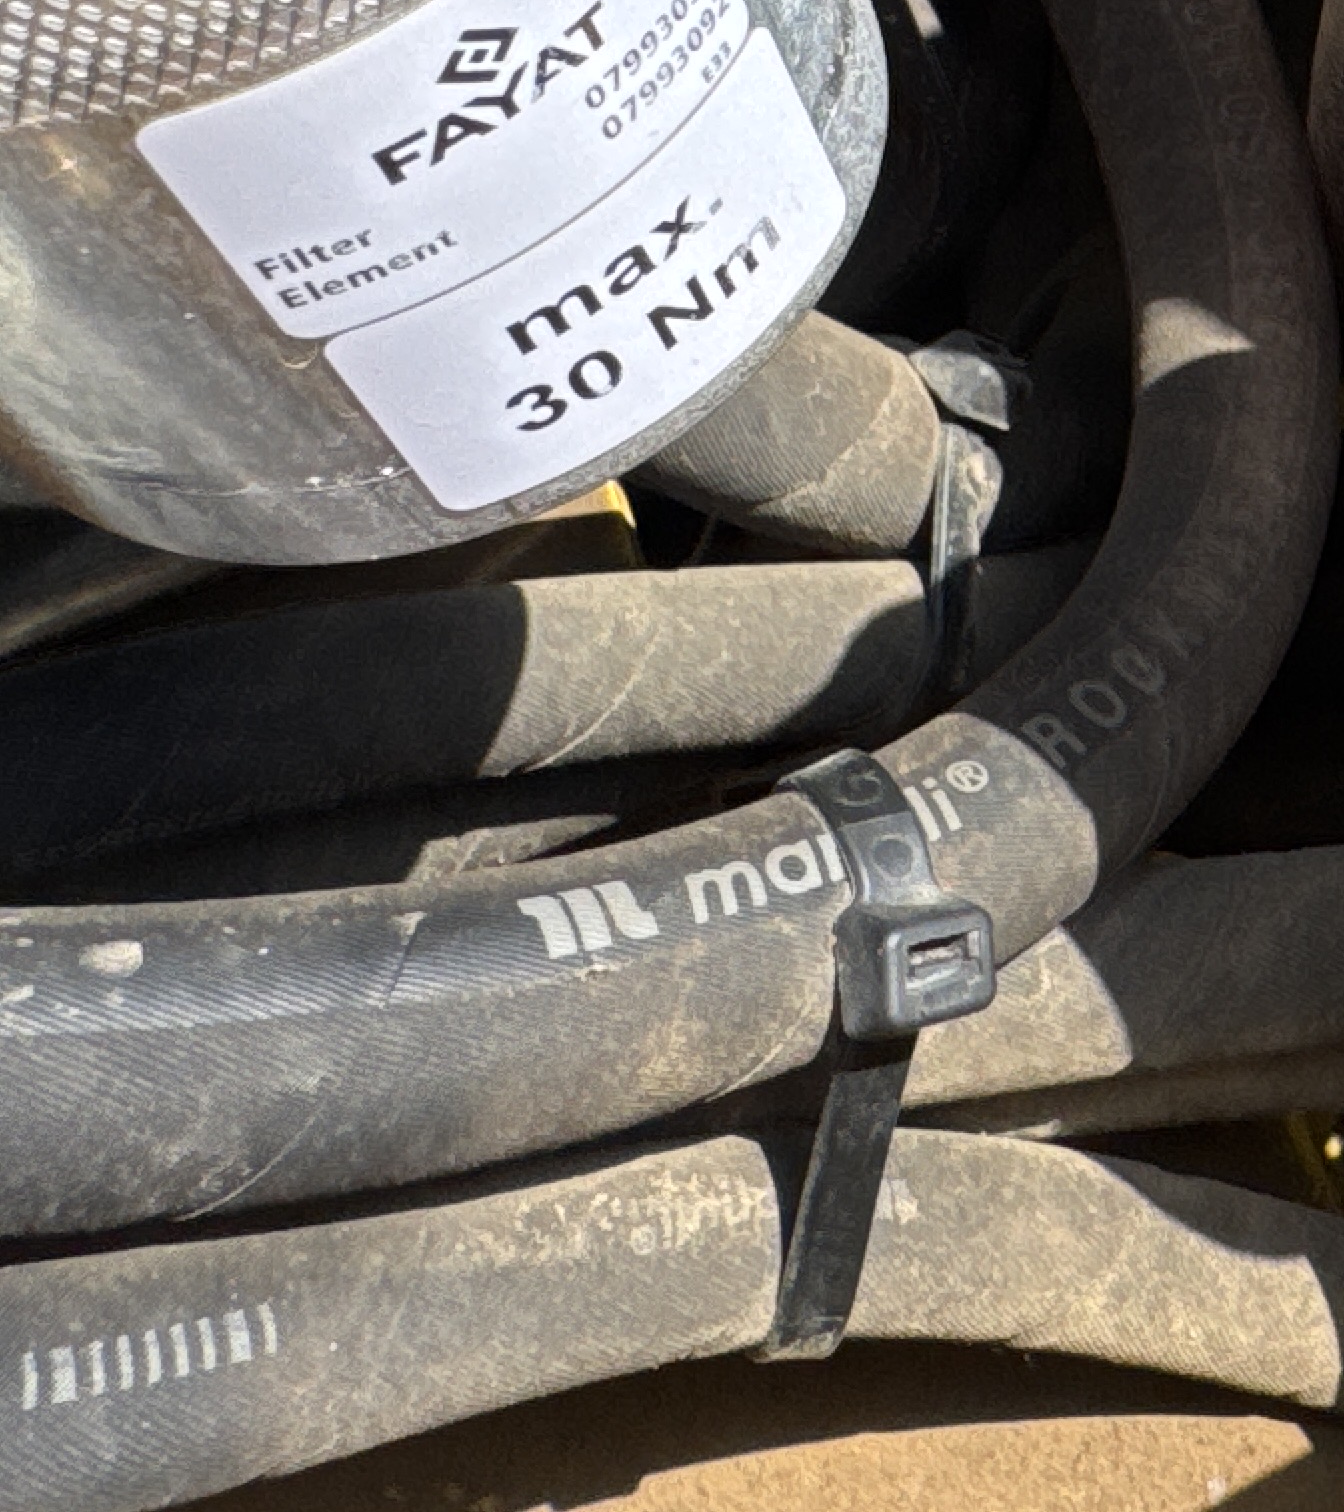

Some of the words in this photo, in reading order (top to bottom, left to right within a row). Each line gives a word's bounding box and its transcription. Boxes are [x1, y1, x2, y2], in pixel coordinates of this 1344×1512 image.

[701, 40, 732, 84] E33
[253, 228, 372, 280] Filter
[277, 229, 458, 310] Element
[505, 194, 723, 356] max.
[505, 349, 624, 432] 30
[646, 215, 781, 351] Nm
